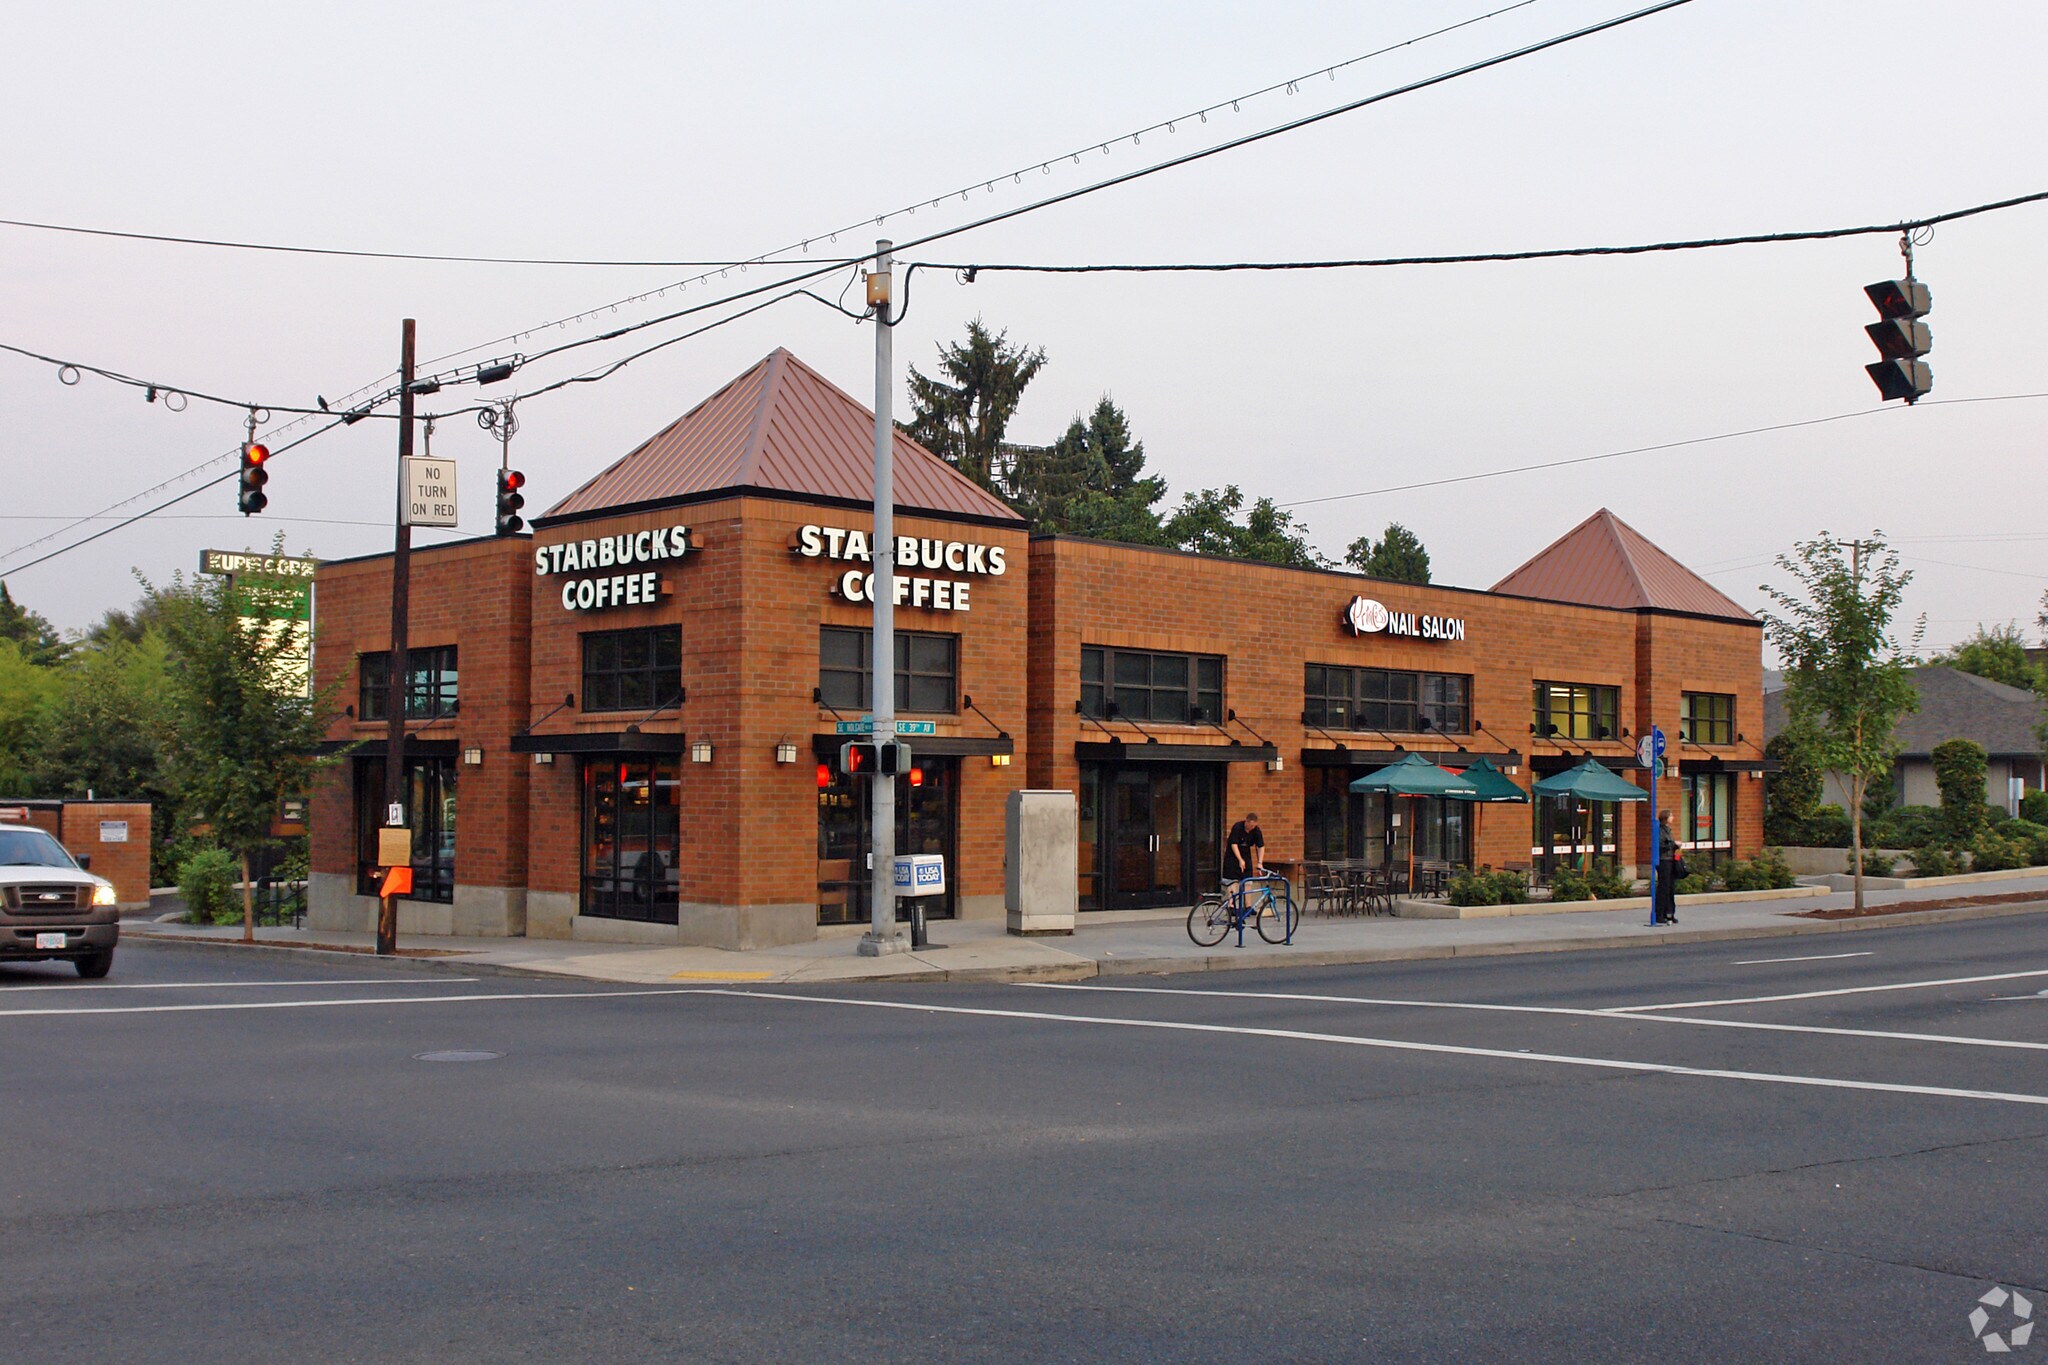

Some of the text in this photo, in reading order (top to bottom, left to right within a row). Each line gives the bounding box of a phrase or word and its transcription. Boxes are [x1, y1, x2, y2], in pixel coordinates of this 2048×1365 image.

[425, 467, 440, 480] NO
[418, 485, 447, 498] TURN
[412, 503, 455, 516] ON RED
[535, 525, 686, 576] STARBUCKS
[800, 524, 1006, 576] STABUCKS
[562, 572, 656, 610] COFFEE
[1389, 611, 1420, 636] NAIL
[1422, 614, 1465, 640] SALON
[898, 722, 906, 732] SE
[924, 866, 938, 874] USA
[918, 873, 940, 882] TODAY
